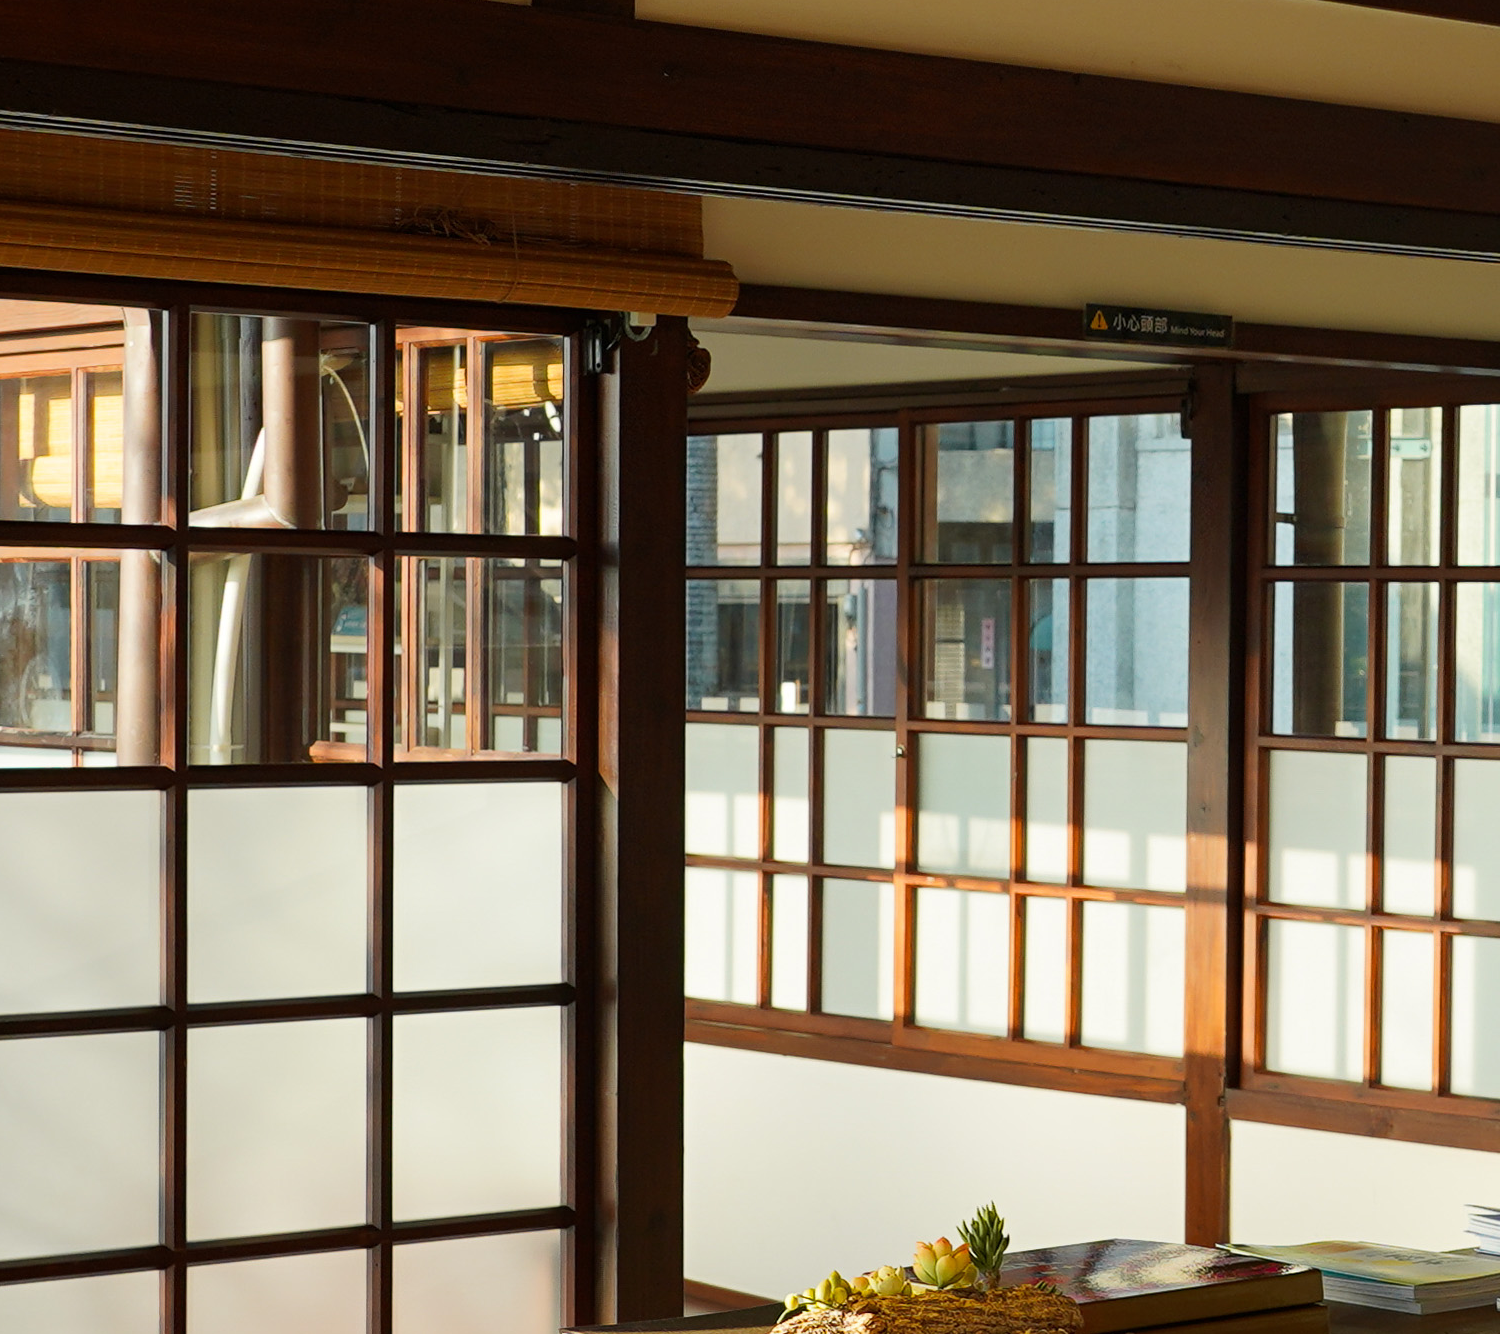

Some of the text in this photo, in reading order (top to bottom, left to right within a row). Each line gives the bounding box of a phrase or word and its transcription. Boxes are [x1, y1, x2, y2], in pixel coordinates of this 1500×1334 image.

[1112, 312, 1169, 334] 小心頭部
[1170, 326, 1226, 339] Mind Your Head
